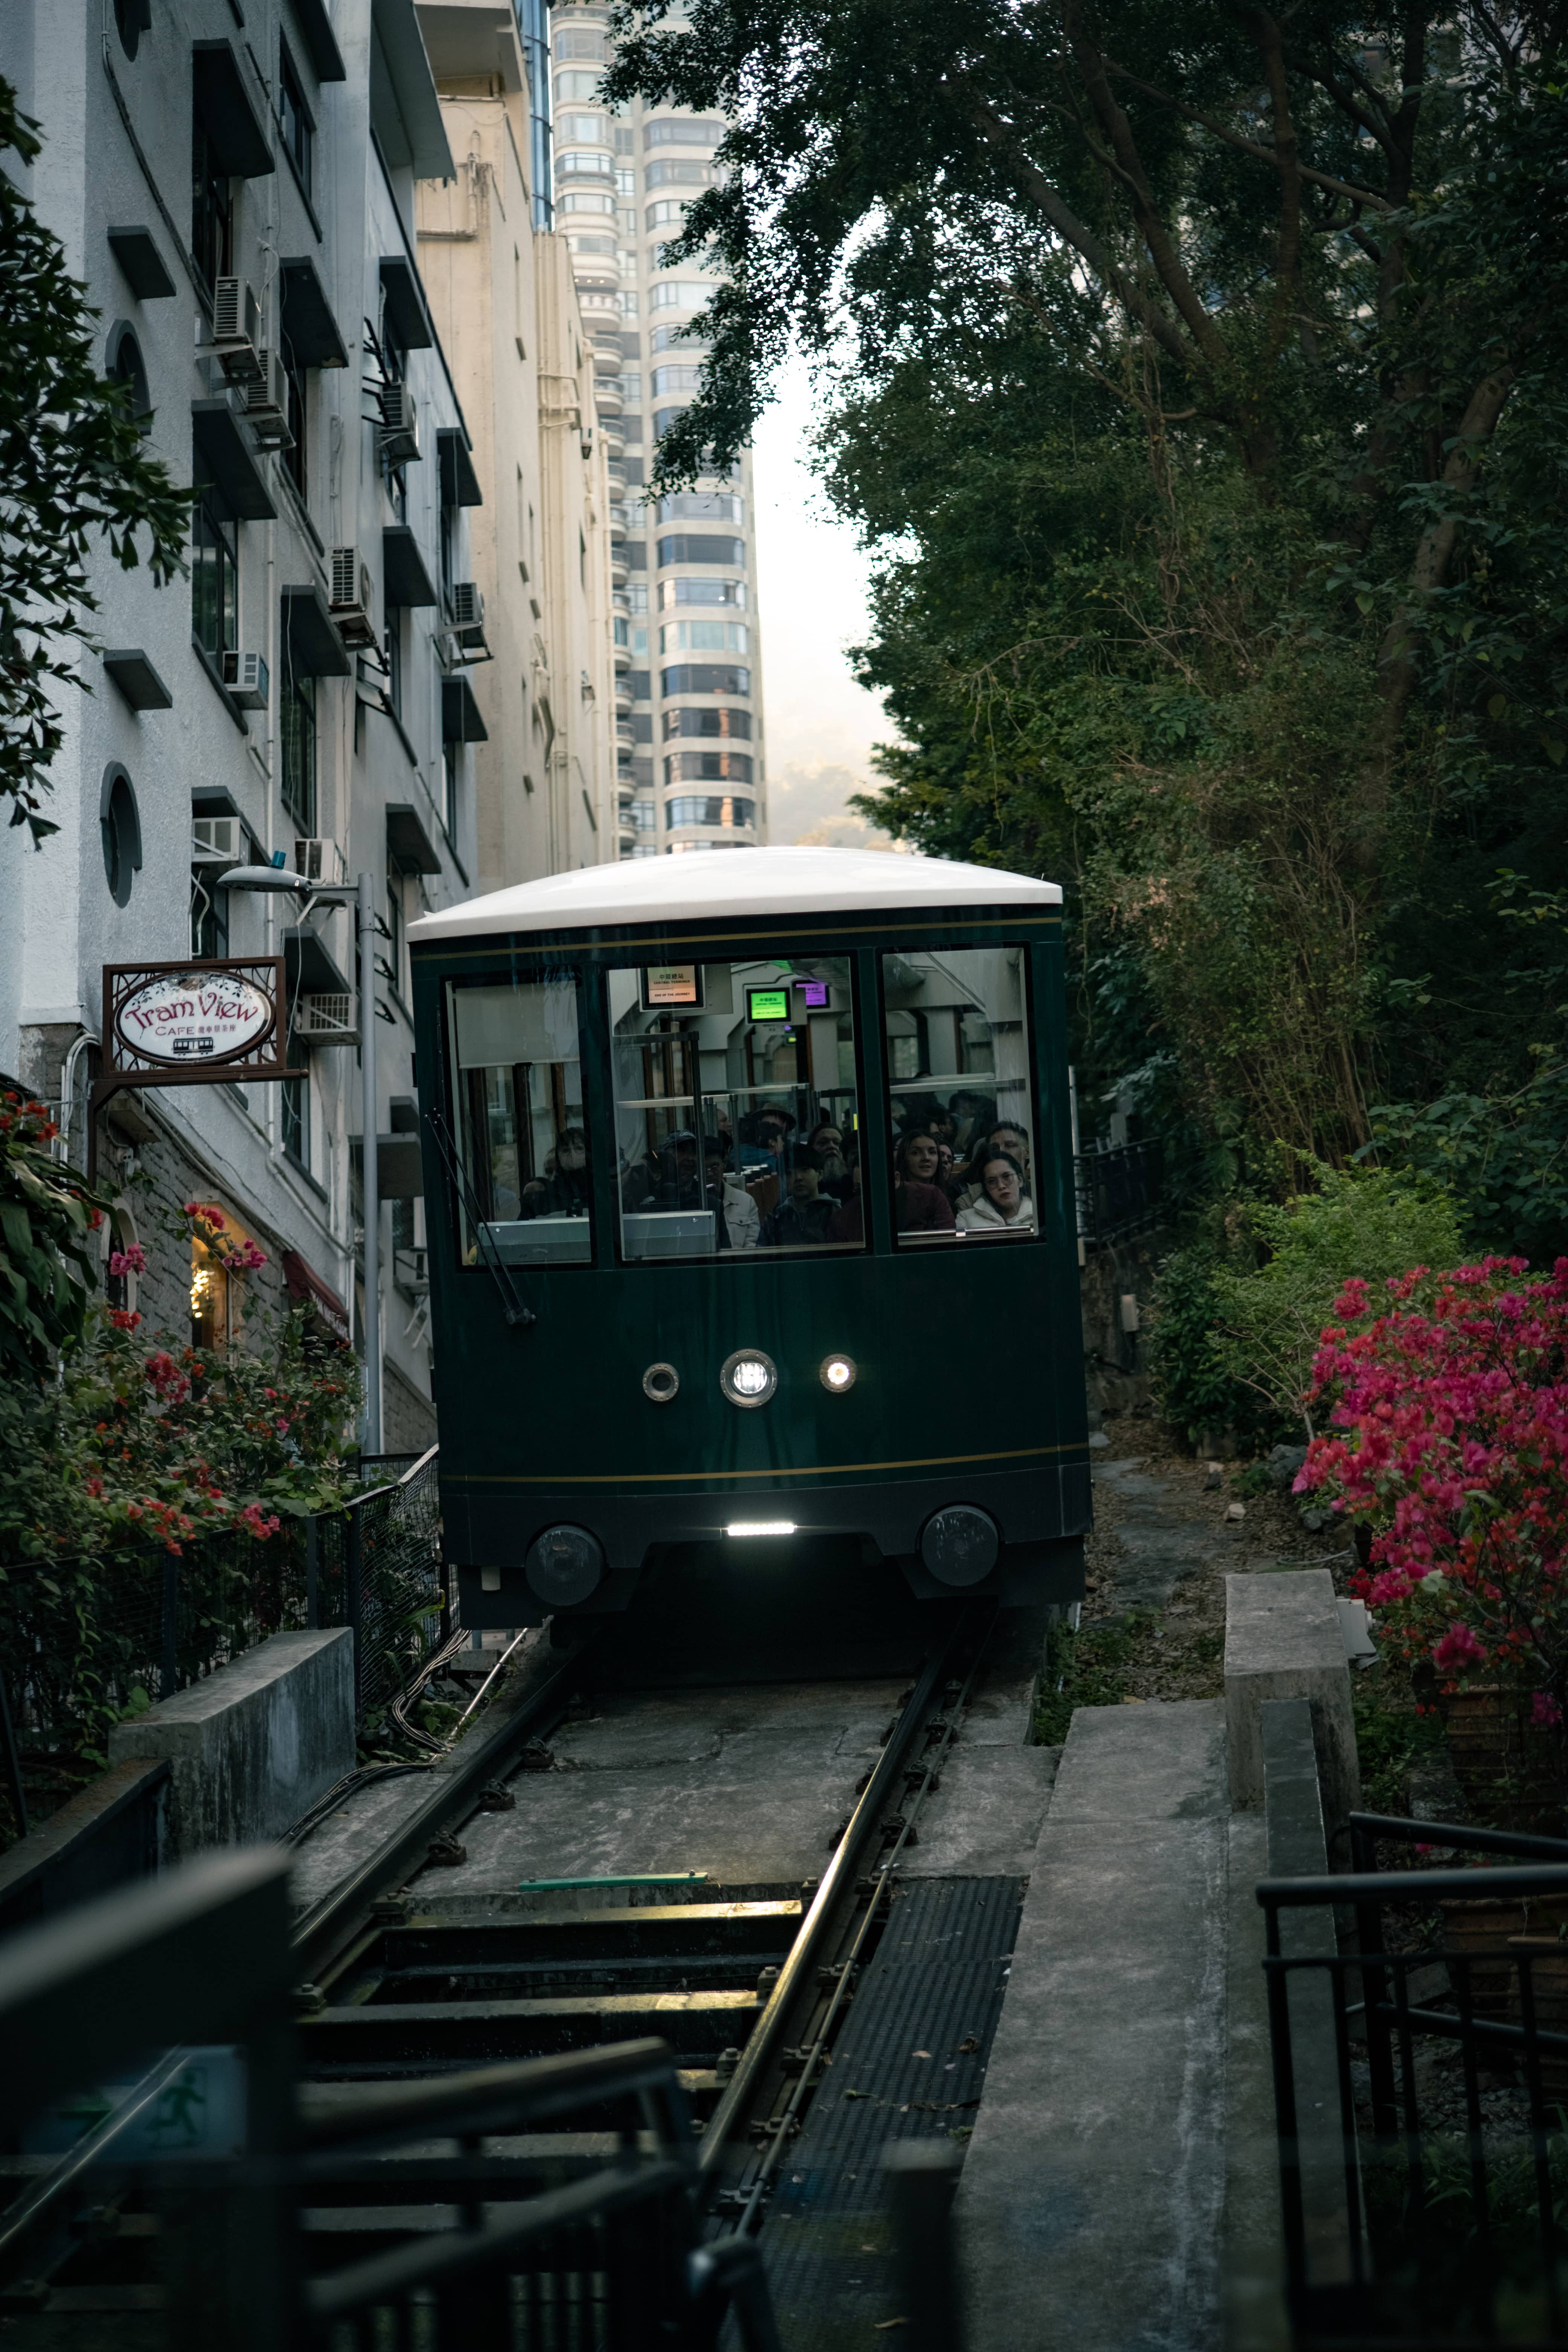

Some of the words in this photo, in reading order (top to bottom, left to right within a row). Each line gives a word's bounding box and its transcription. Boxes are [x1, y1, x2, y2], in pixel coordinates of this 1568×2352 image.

[125, 1001, 194, 1029] Tram
[198, 992, 258, 1022] View
[155, 1026, 194, 1036] CAFE
